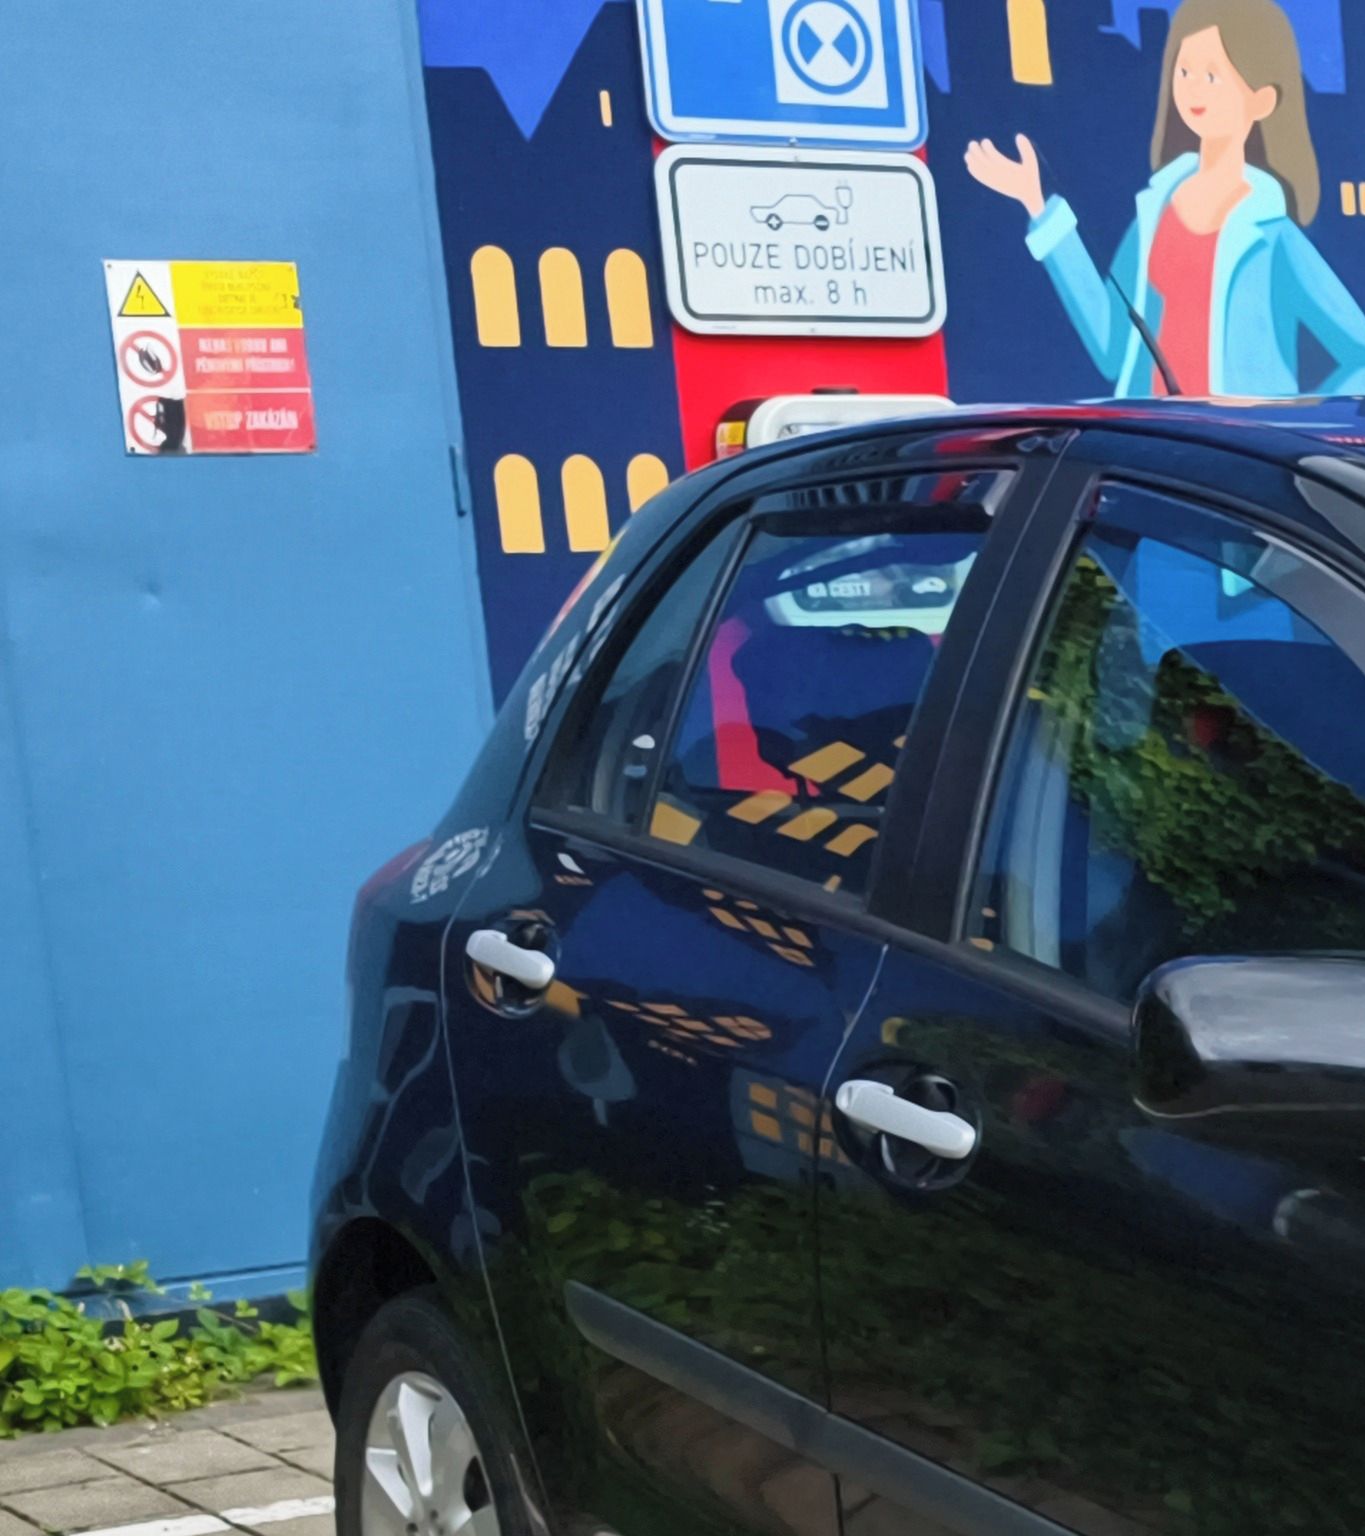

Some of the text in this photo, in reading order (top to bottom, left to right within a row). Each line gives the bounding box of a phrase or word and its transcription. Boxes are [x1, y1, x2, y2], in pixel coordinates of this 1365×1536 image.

[693, 237, 916, 272] POUZE DOBÍJENÍ
[754, 280, 867, 306] max. 8 h
